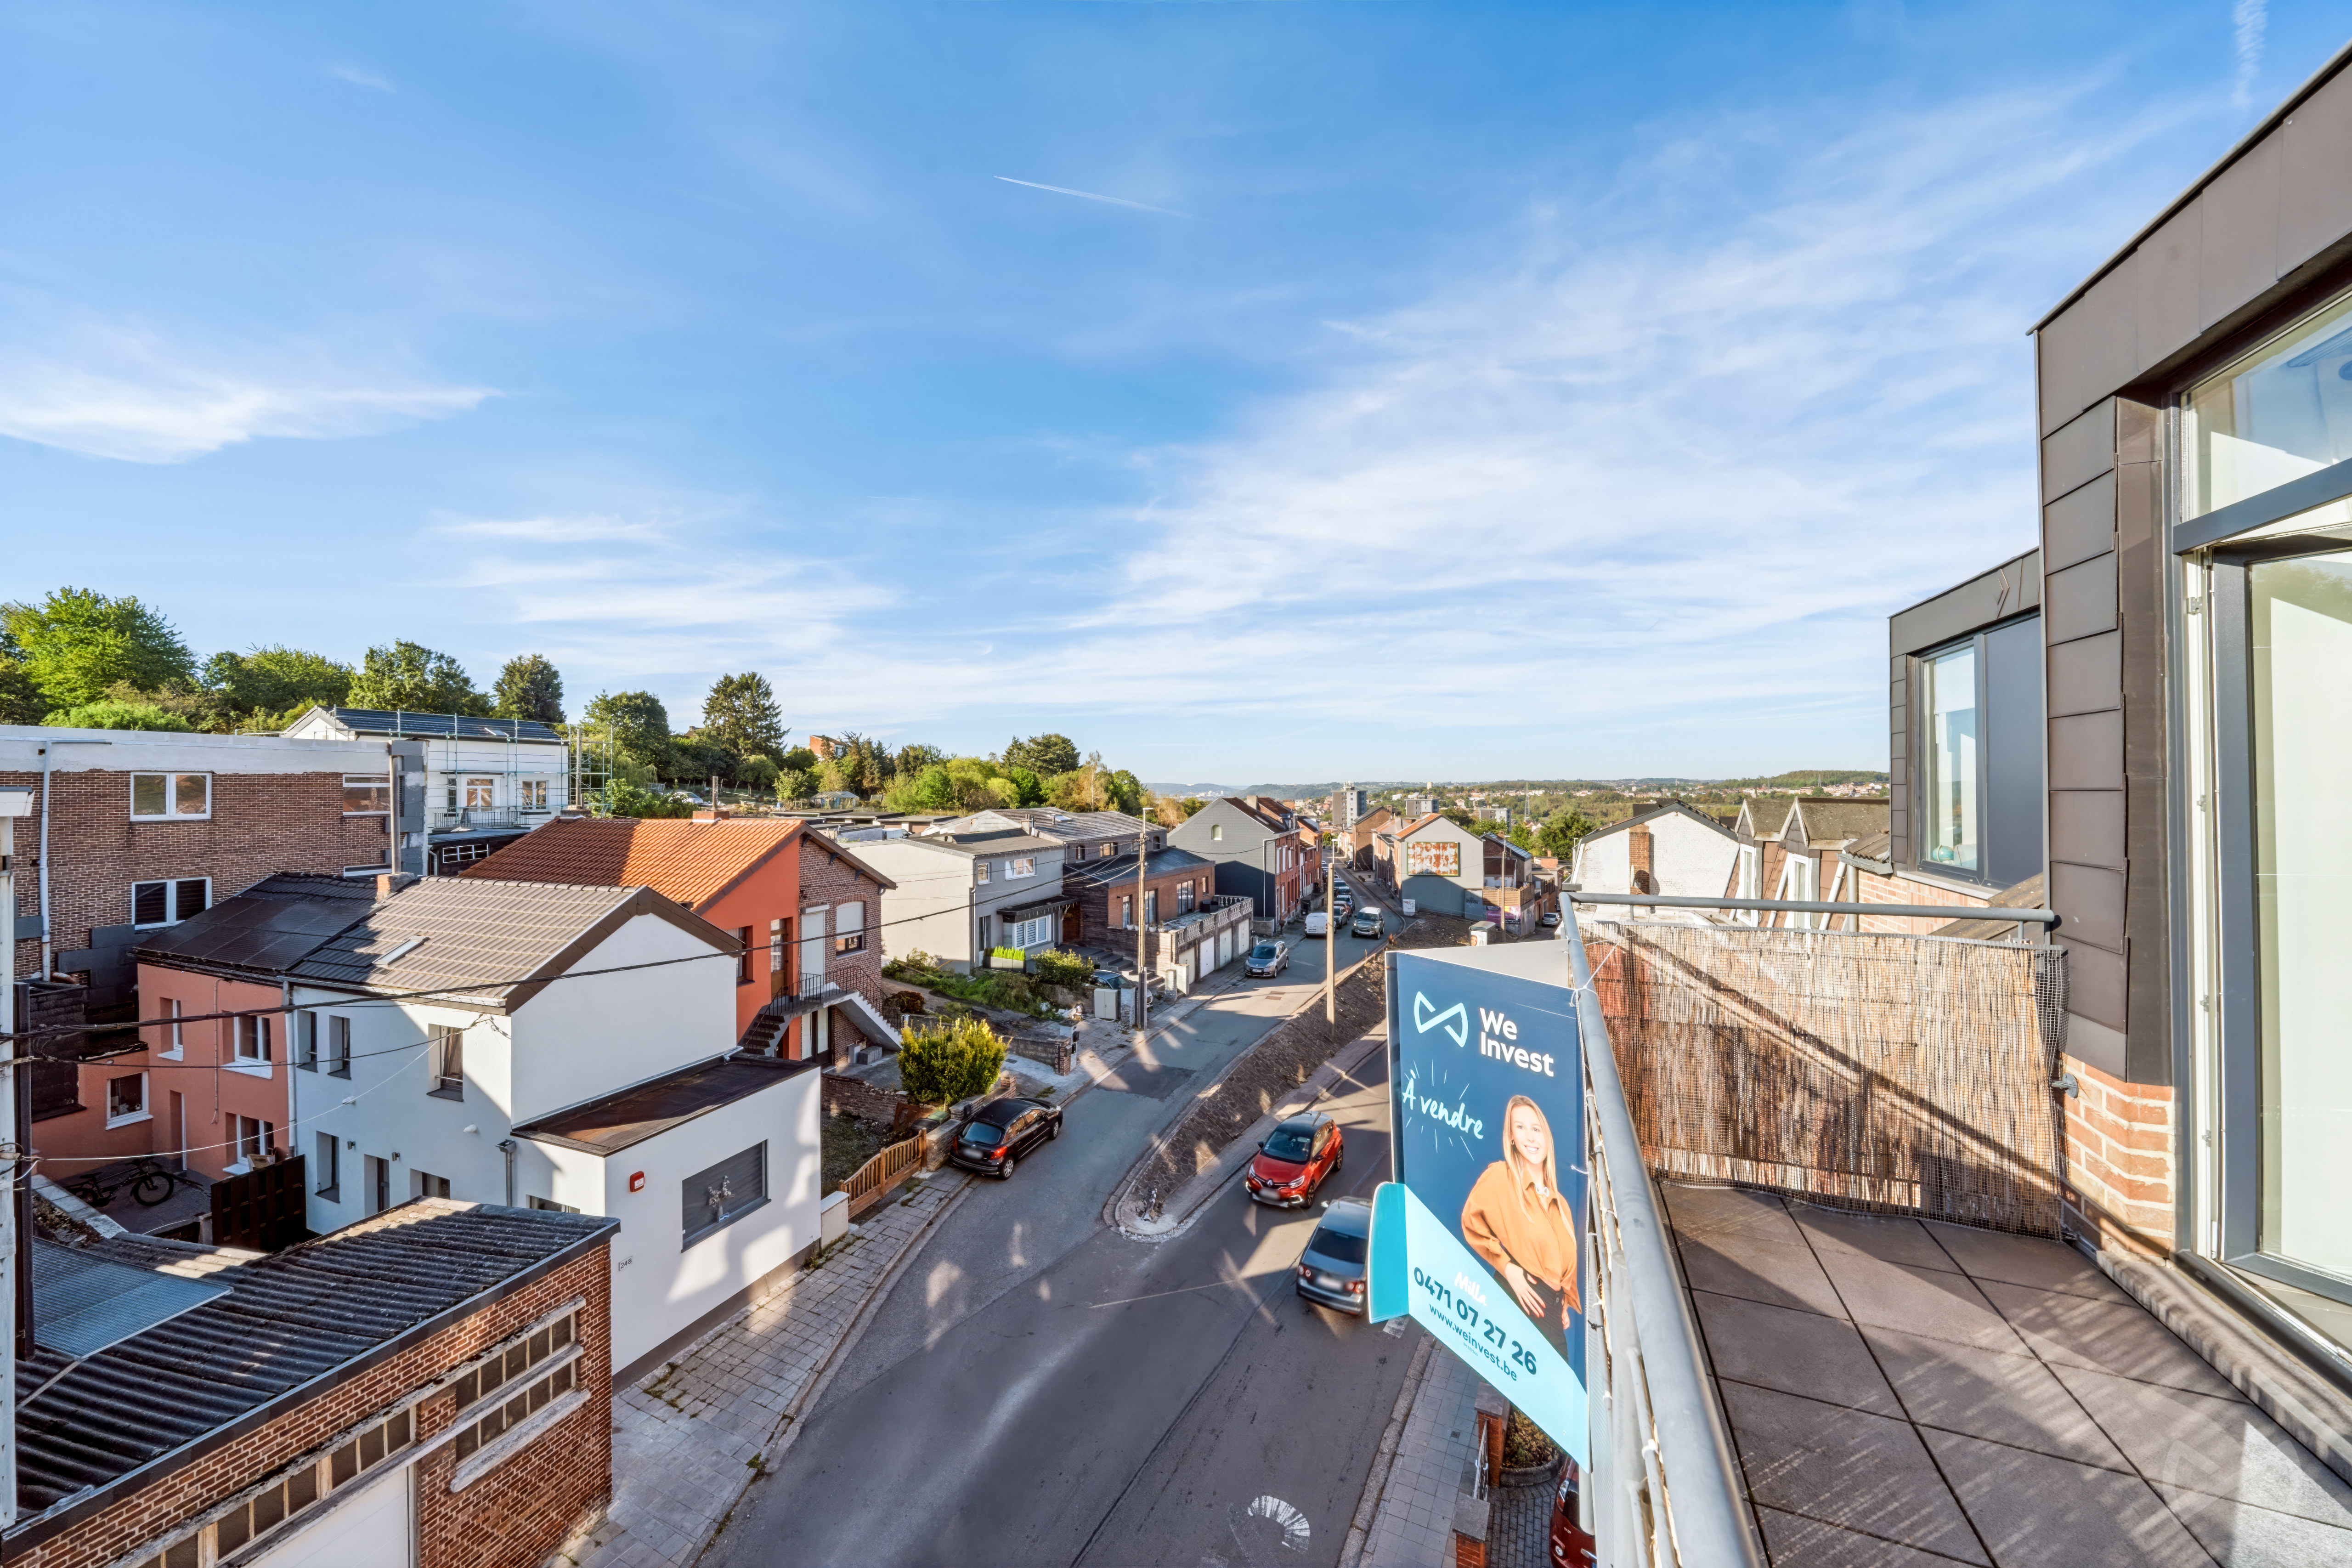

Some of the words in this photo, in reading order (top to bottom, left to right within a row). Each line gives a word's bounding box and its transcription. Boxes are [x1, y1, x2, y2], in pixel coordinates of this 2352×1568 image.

[1480, 1008, 1517, 1040] We
[1481, 1031, 1554, 1077] Invest
[1402, 1069, 1416, 1110] À
[1420, 1096, 1484, 1139] vendre
[620, 1258, 632, 1269] 248
[1454, 1271, 1487, 1306] Milla
[1414, 1267, 1451, 1309] 0471
[1457, 1299, 1478, 1328] 07
[1484, 1319, 1506, 1349] 27
[1511, 1340, 1537, 1375] 26
[1429, 1304, 1517, 1381] www.weinvest.be
